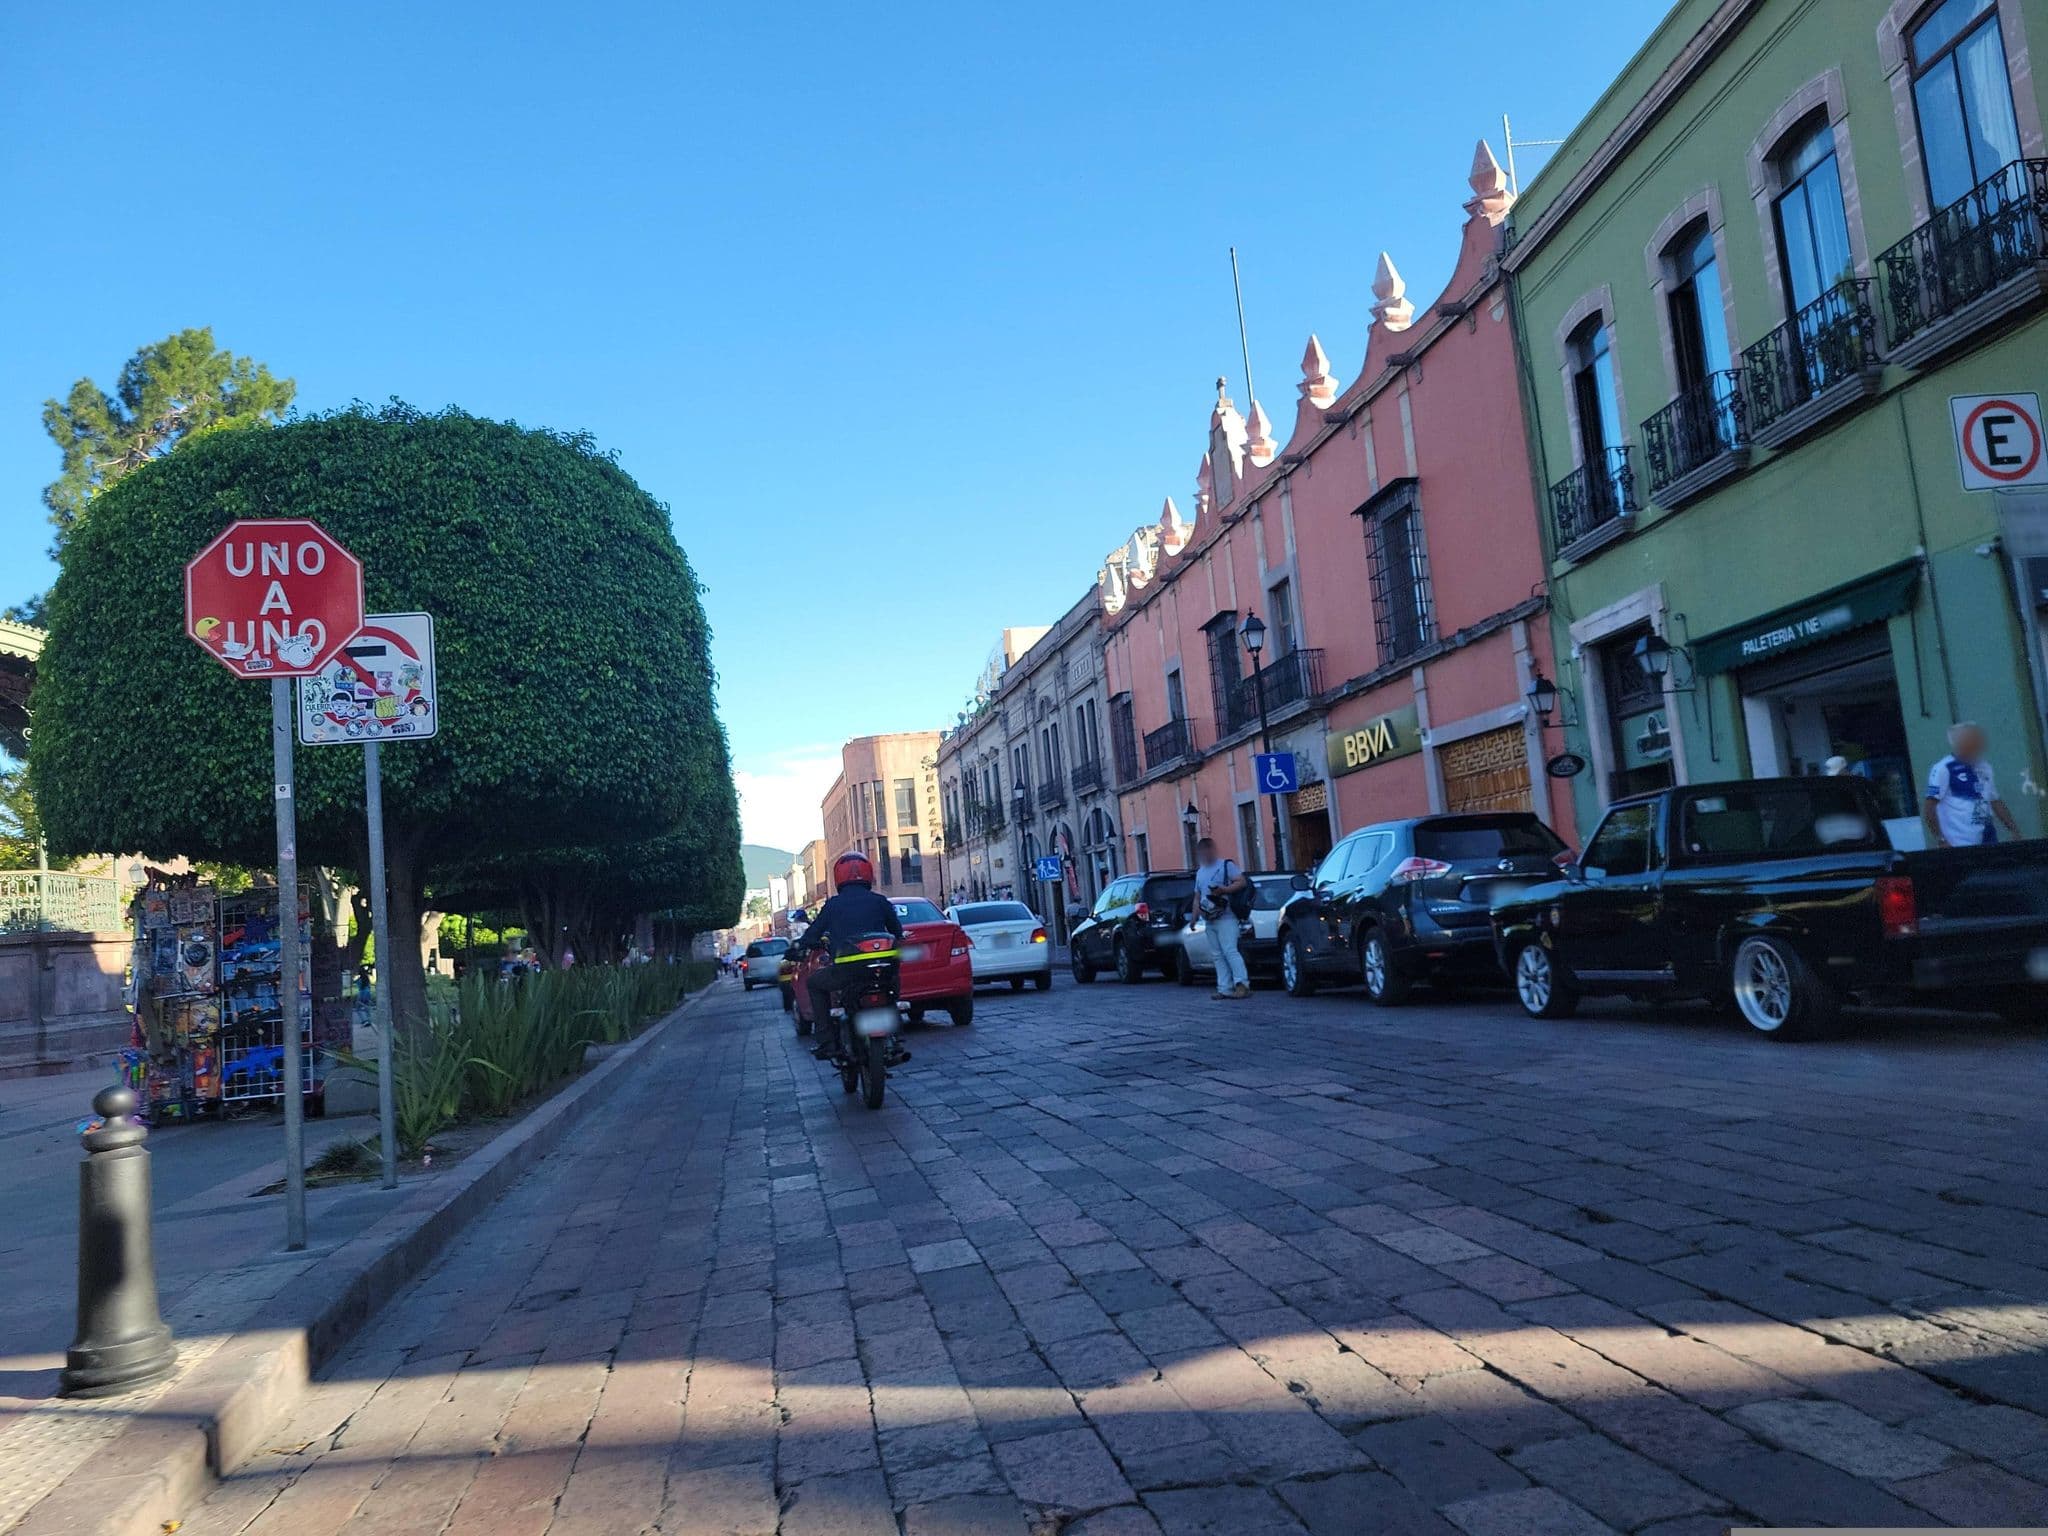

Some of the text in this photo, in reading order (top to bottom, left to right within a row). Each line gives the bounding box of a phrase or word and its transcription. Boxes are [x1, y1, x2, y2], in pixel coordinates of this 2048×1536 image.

[1982, 415, 2022, 466] E
[226, 541, 326, 577] UNO
[259, 580, 293, 615] A
[227, 618, 327, 655] UNO
[1741, 626, 1796, 656] PALETERIA
[1343, 718, 1394, 768] BBVA
